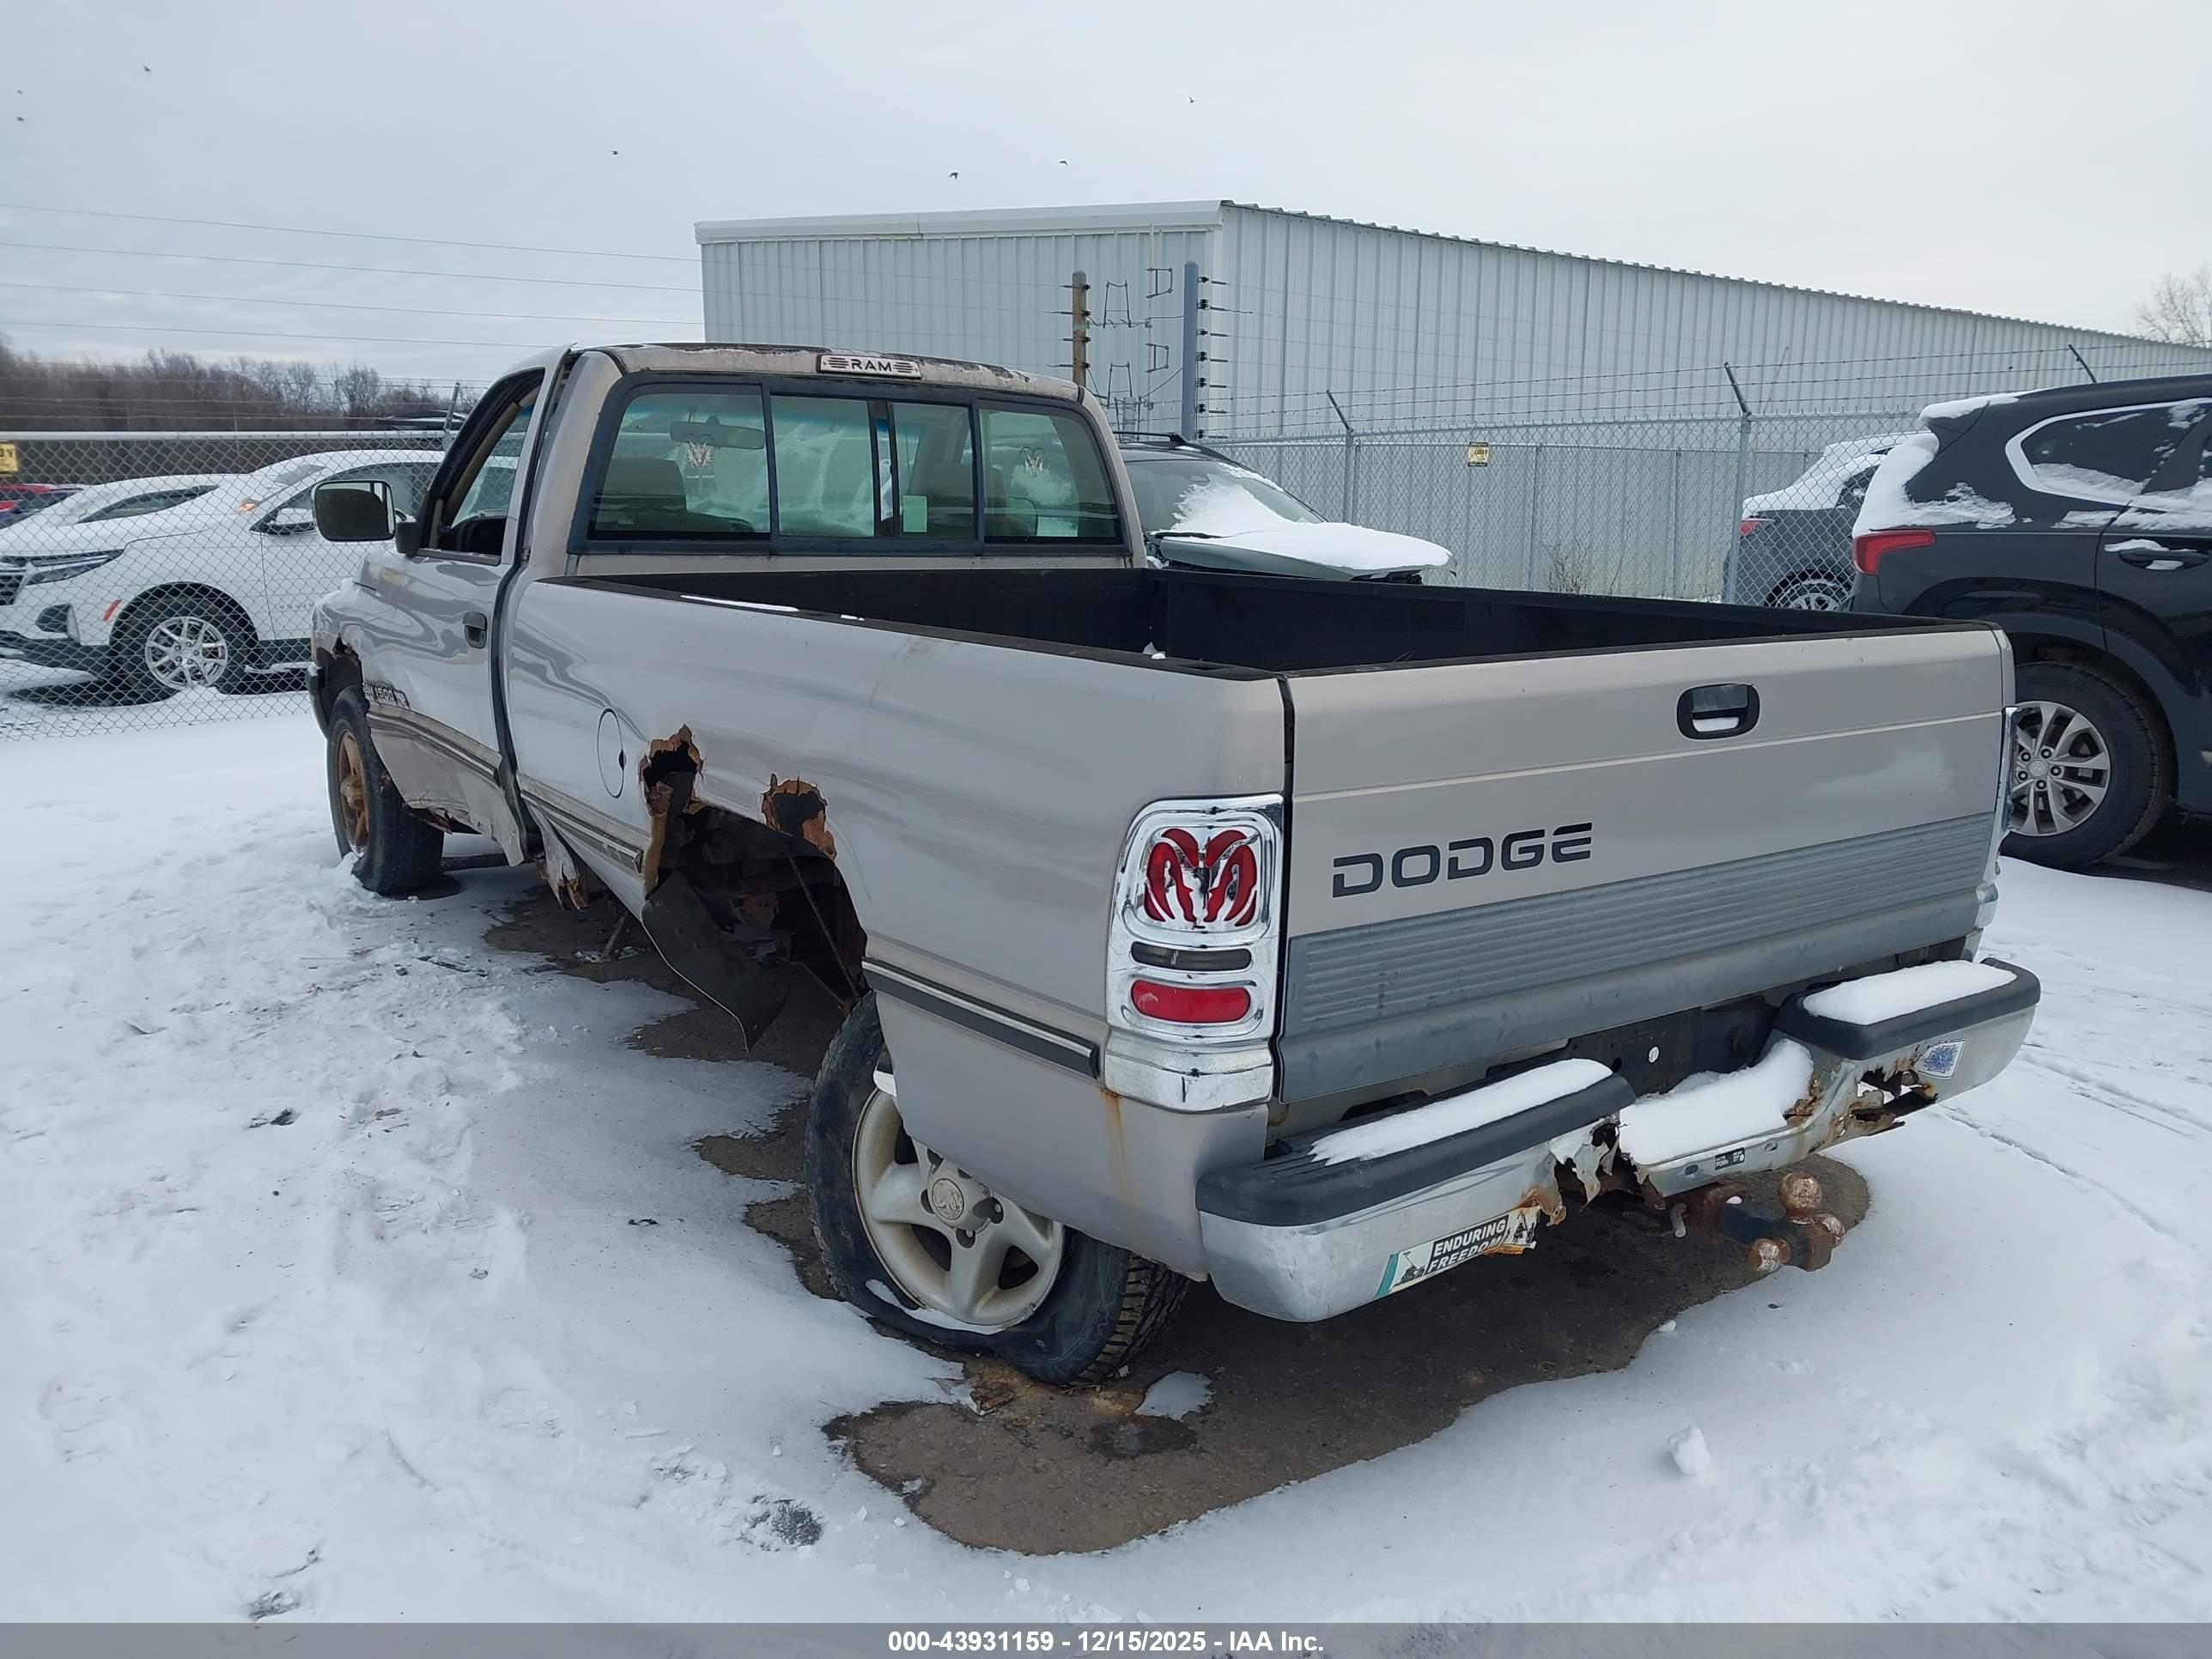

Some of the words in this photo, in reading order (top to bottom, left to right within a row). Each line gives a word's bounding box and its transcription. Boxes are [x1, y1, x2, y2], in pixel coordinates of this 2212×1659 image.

[851, 359, 891, 372] RAM
[374, 687, 394, 701] 1500
[1332, 822, 1593, 898] DODGE
[1428, 1235, 1504, 1273] FREEDOM
[1433, 1219, 1506, 1258] ENDURING
